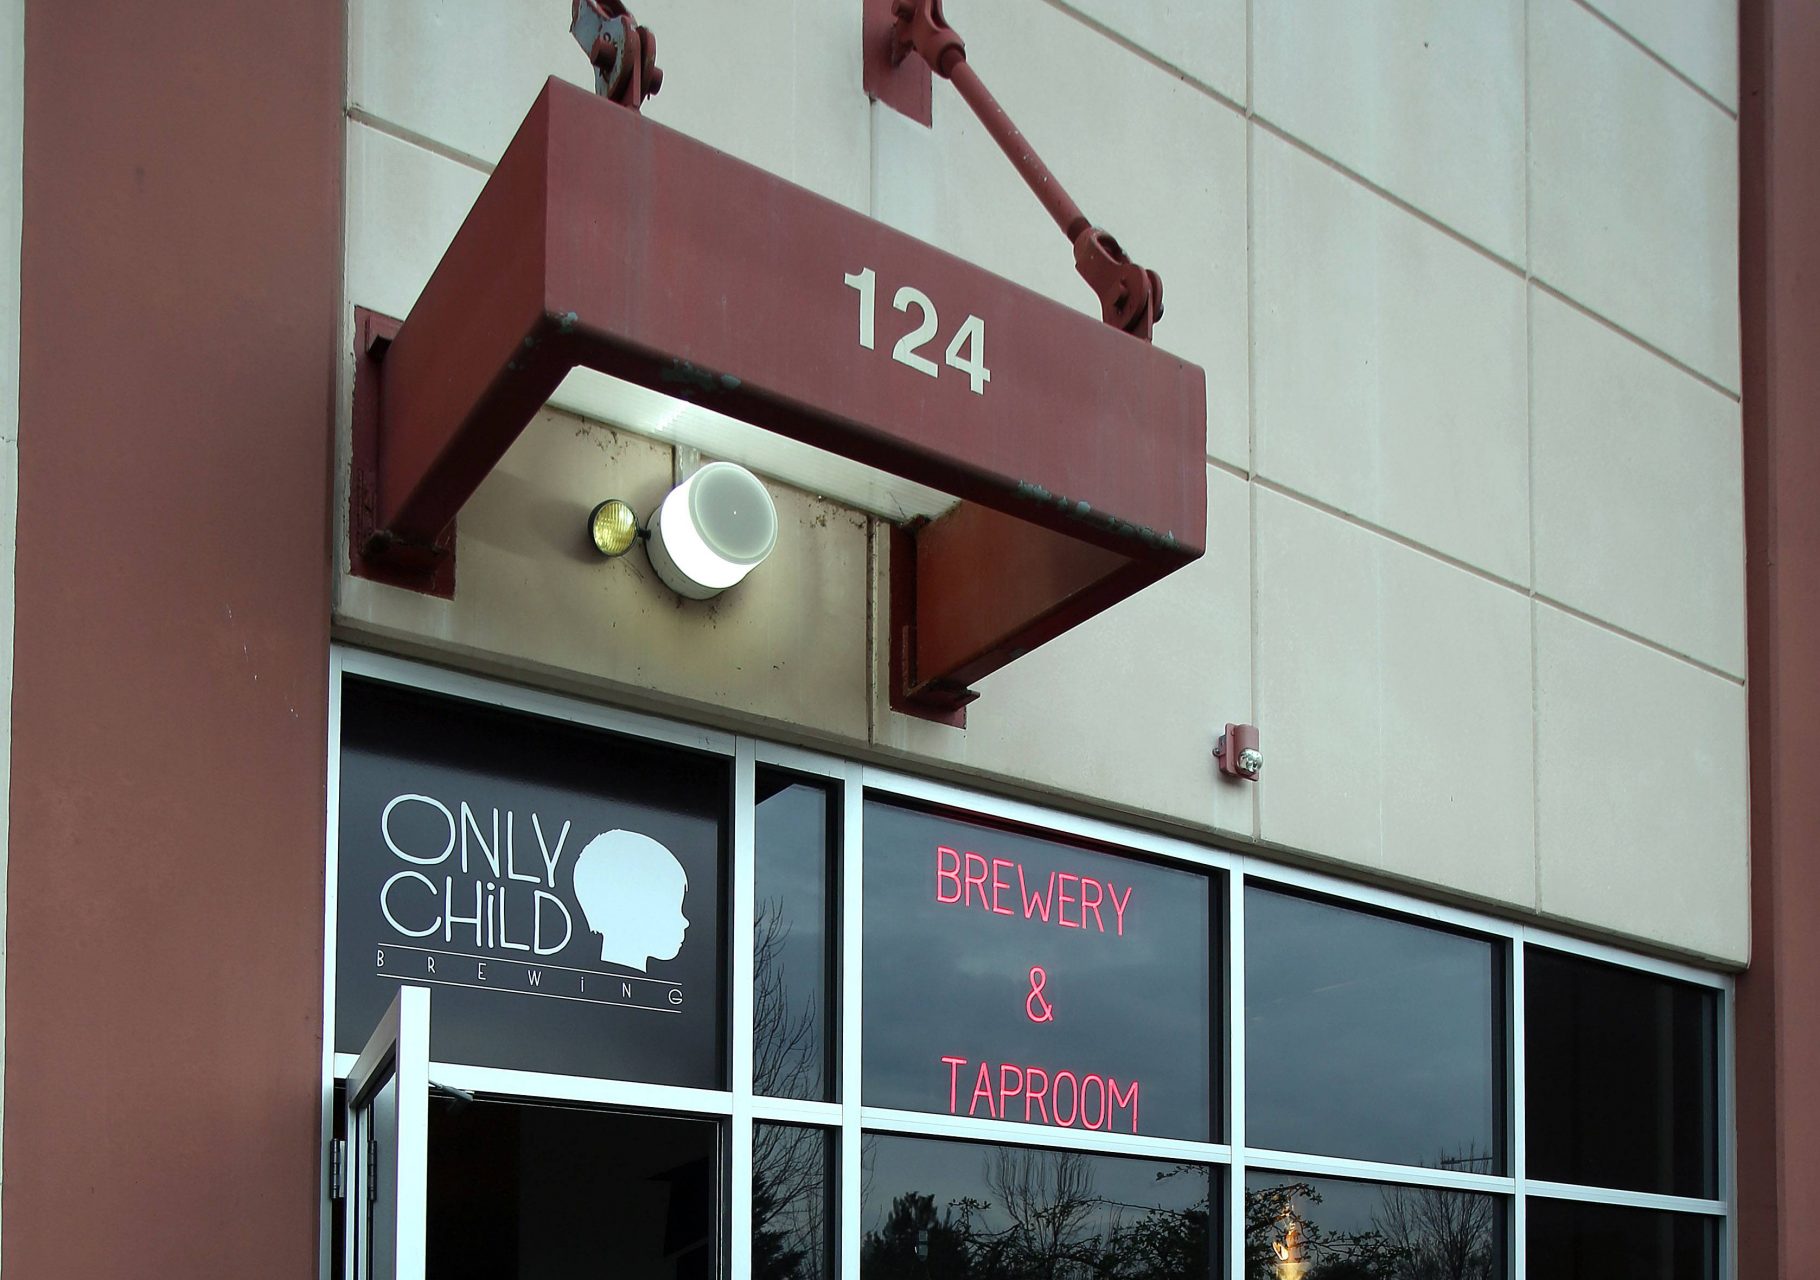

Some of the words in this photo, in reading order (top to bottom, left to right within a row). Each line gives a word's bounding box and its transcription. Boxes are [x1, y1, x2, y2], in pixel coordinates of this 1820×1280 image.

[844, 266, 991, 396] 124
[381, 794, 571, 888] ONLY
[936, 846, 1132, 936] BREWERY
[1026, 965, 1054, 1023] &
[941, 1055, 1139, 1133] TAPROOM
